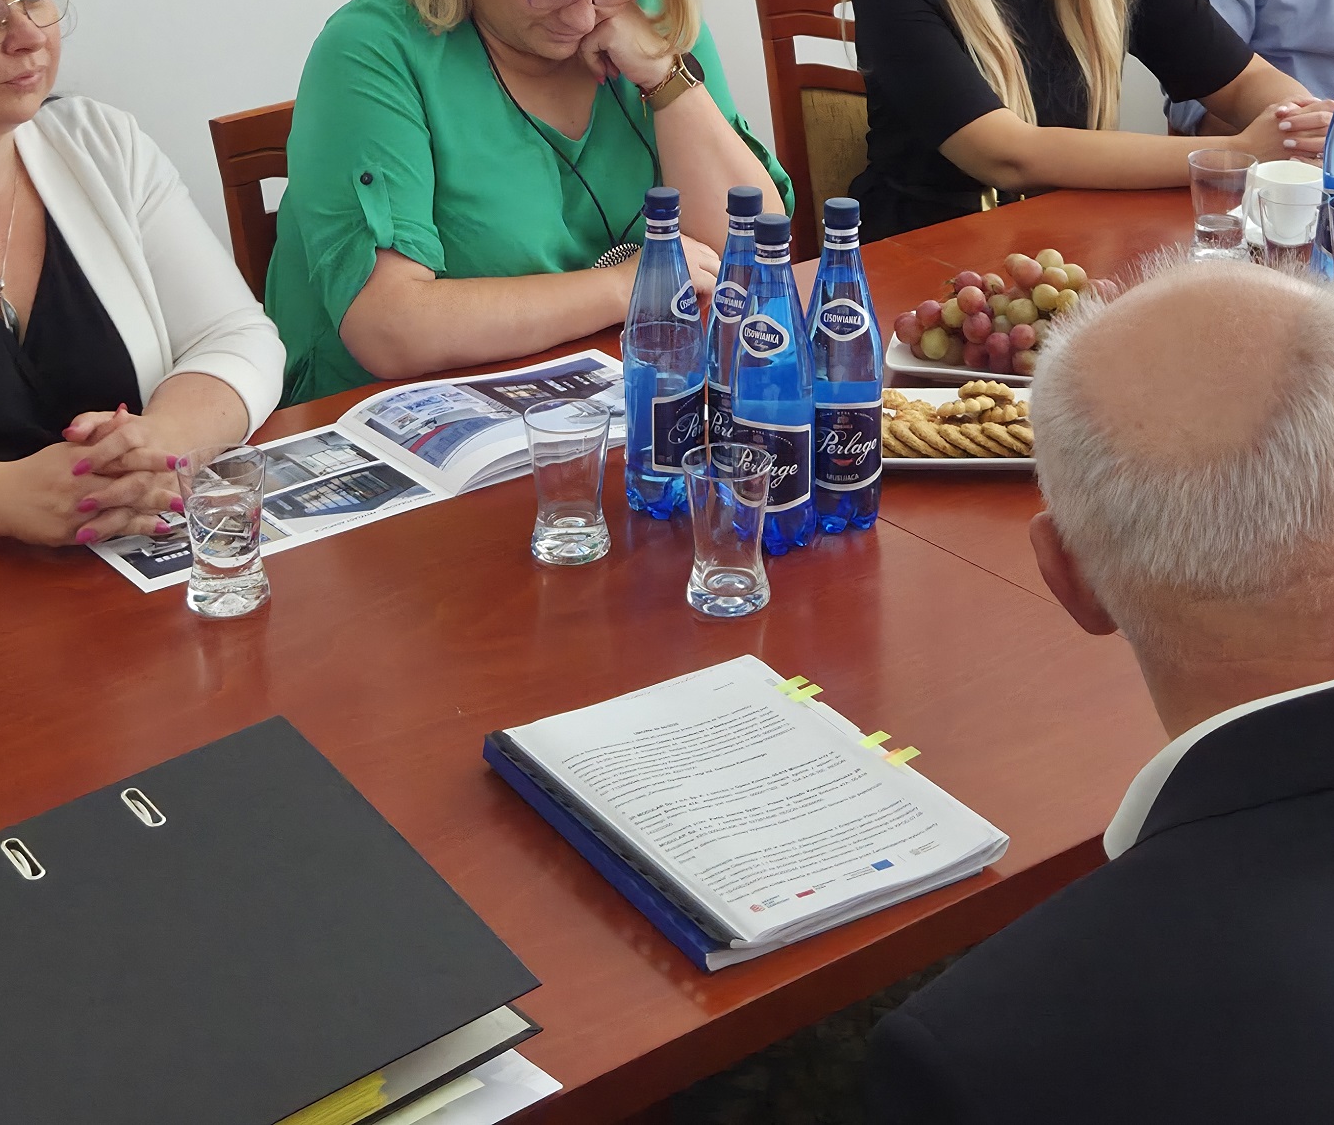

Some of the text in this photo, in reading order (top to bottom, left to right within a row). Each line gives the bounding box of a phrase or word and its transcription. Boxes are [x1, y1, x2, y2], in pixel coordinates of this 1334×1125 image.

[823, 312, 861, 325] CISOWIANKA
[744, 327, 779, 344] CISOWIANKA
[817, 427, 877, 465] Perlage
